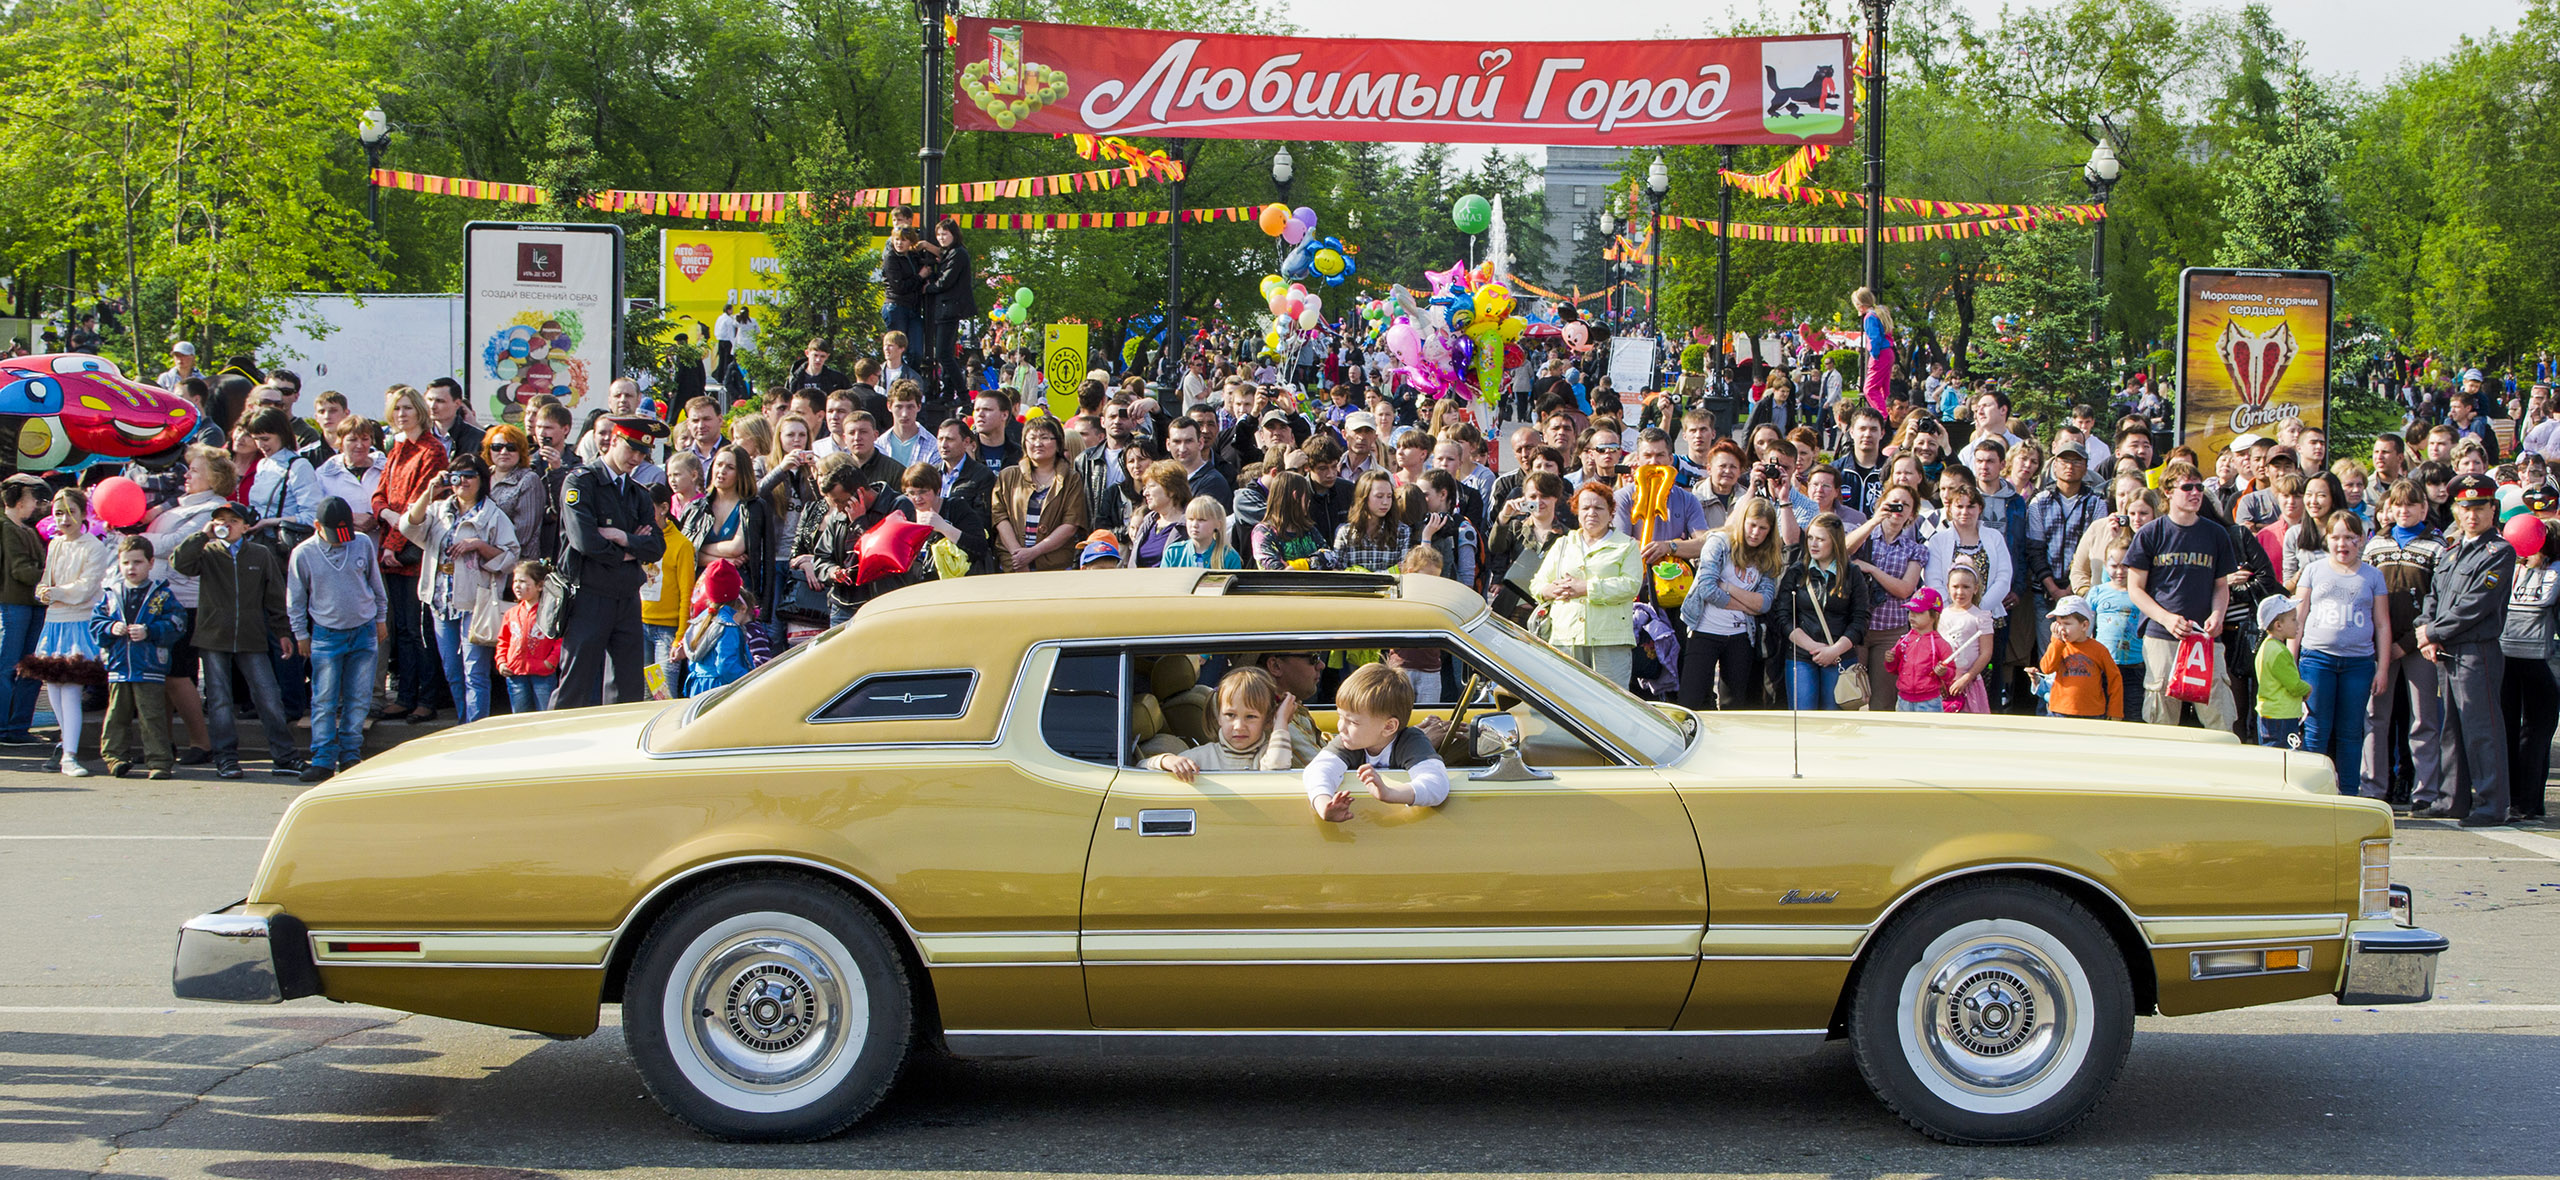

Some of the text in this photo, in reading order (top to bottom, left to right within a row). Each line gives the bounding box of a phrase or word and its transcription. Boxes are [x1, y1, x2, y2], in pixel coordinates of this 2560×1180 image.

[1080, 38, 1731, 132] Любимый Город
[674, 247, 694, 256] ЛЕТО
[681, 256, 710, 265] ВМЕСТЕ
[680, 266, 699, 274] С СТС
[481, 289, 598, 301] СОЗДАЙ ВЕСЕННИЙ ОБРАЗ
[727, 289, 738, 305] Я
[2200, 290, 2319, 307] Мороженое с горячим
[2228, 305, 2285, 317] сердцем
[1053, 378, 1079, 391] GYM
[2229, 402, 2301, 434] Cornetto
[2153, 552, 2214, 569] AUSTRALIA
